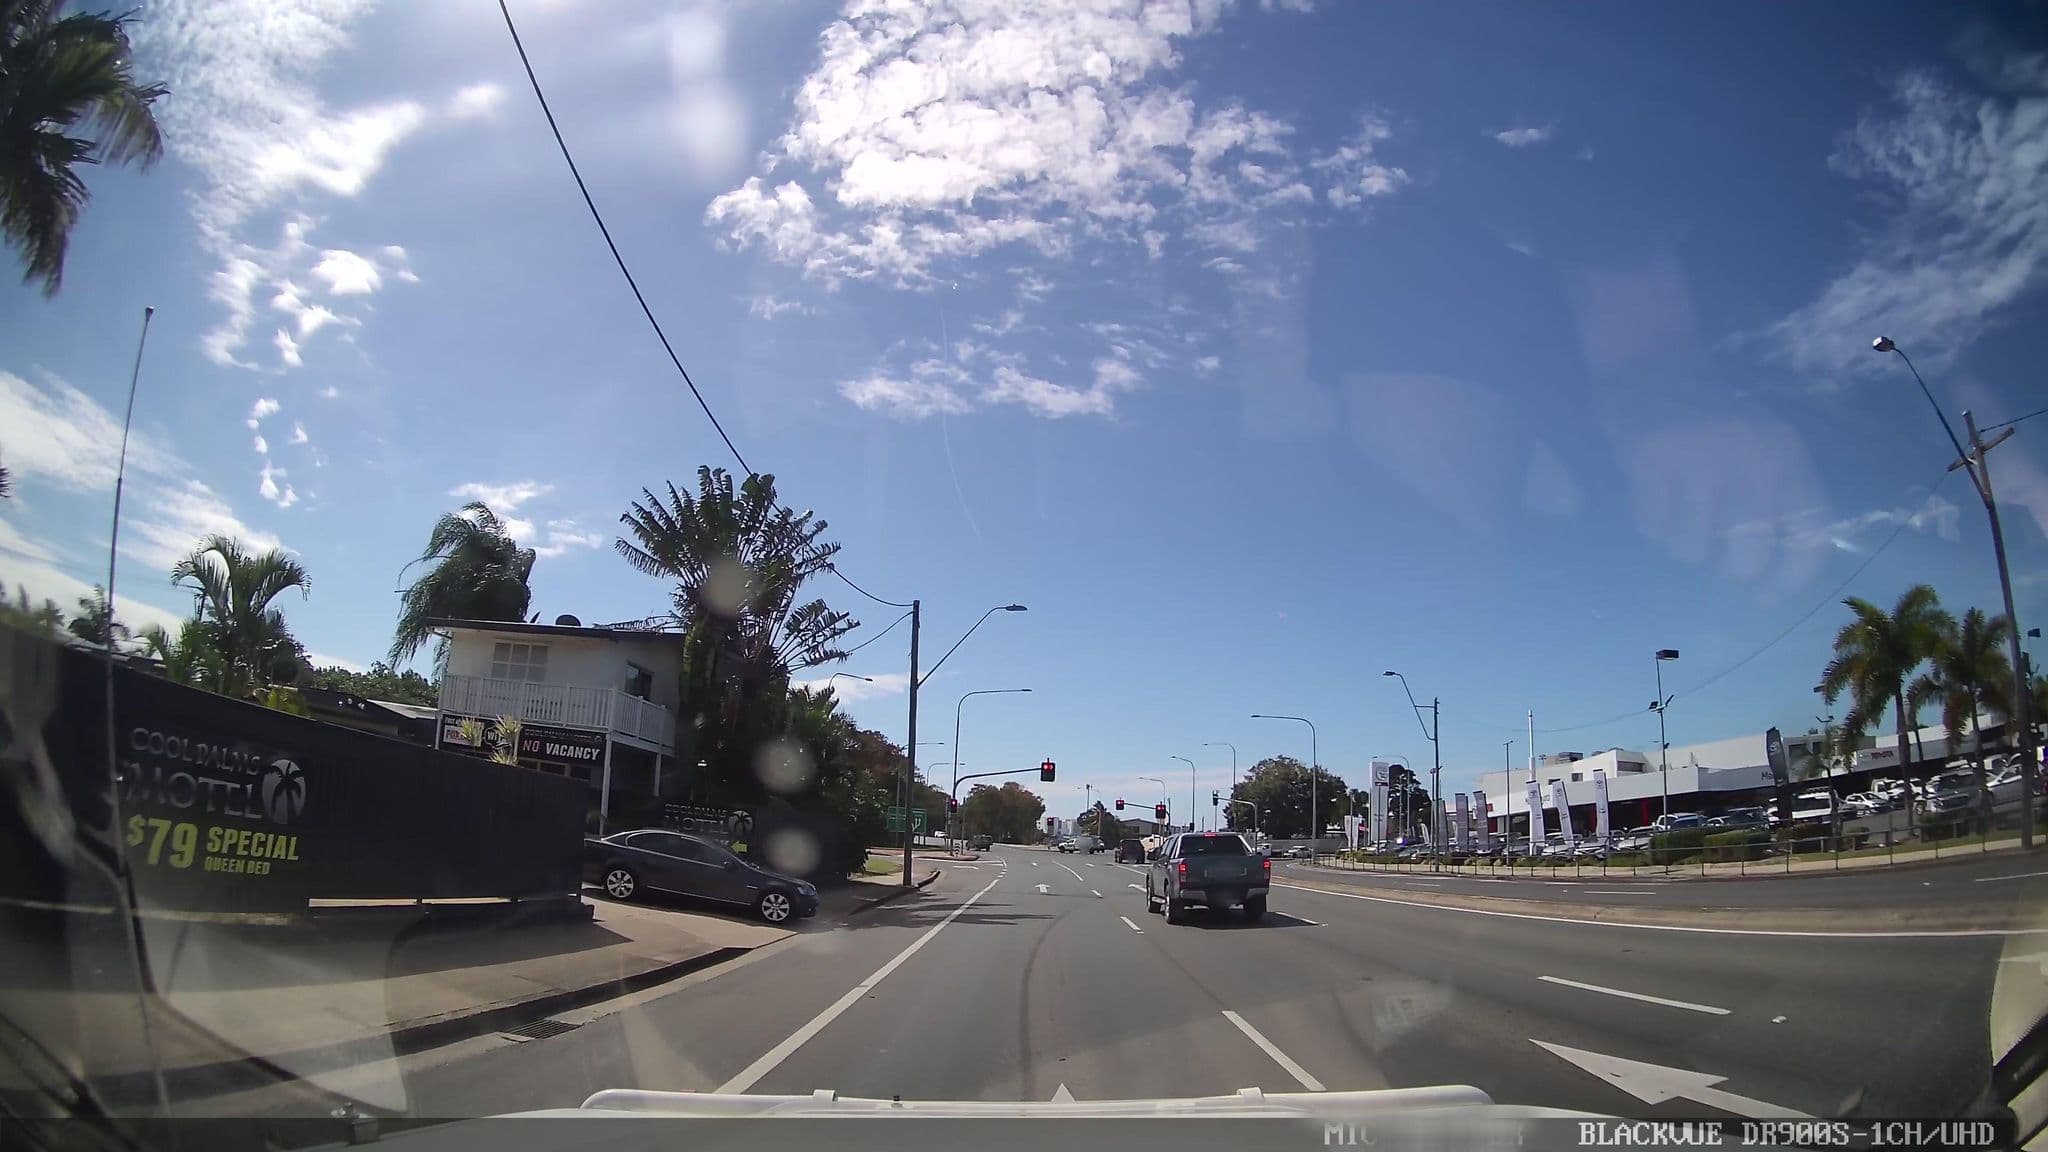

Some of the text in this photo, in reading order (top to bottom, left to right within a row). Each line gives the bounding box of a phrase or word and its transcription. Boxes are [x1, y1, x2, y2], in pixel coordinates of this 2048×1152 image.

[130, 727, 262, 776] COOL PALMS
[522, 739, 600, 761] NO VACANCY
[126, 761, 263, 819] MOTEL
[126, 813, 300, 869] $79 SPECIAL
[204, 856, 245, 873] QUEEN
